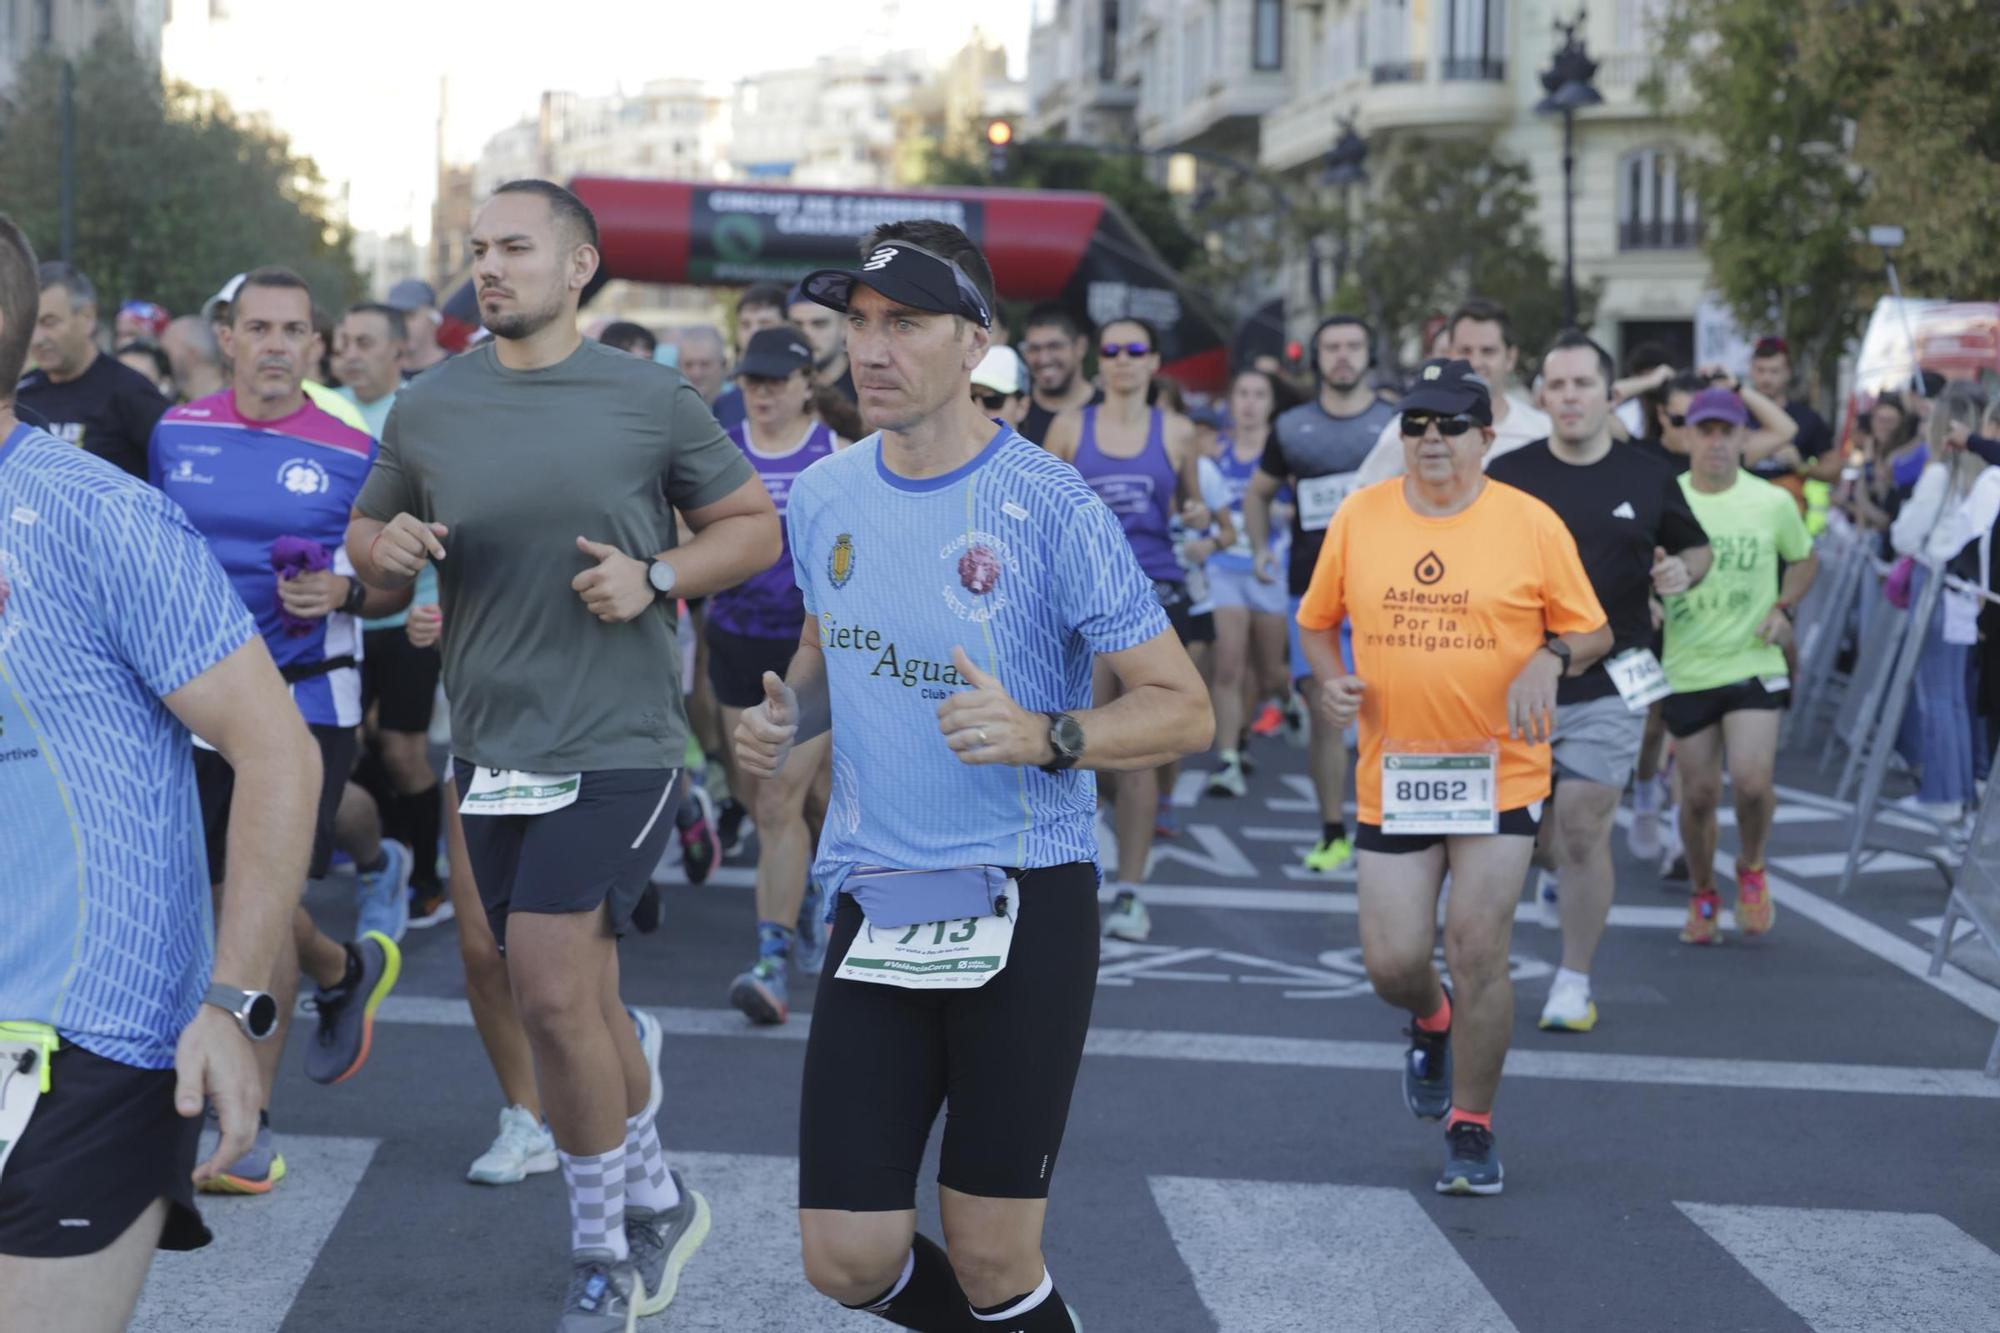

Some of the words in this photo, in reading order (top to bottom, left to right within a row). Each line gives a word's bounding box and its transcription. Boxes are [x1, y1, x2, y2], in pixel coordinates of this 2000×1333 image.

[1384, 586, 1469, 604] Asleuval
[1393, 614, 1430, 631] Por
[1438, 617, 1457, 631] la
[921, 688, 946, 700] Club
[1396, 780, 1468, 801] 8062
